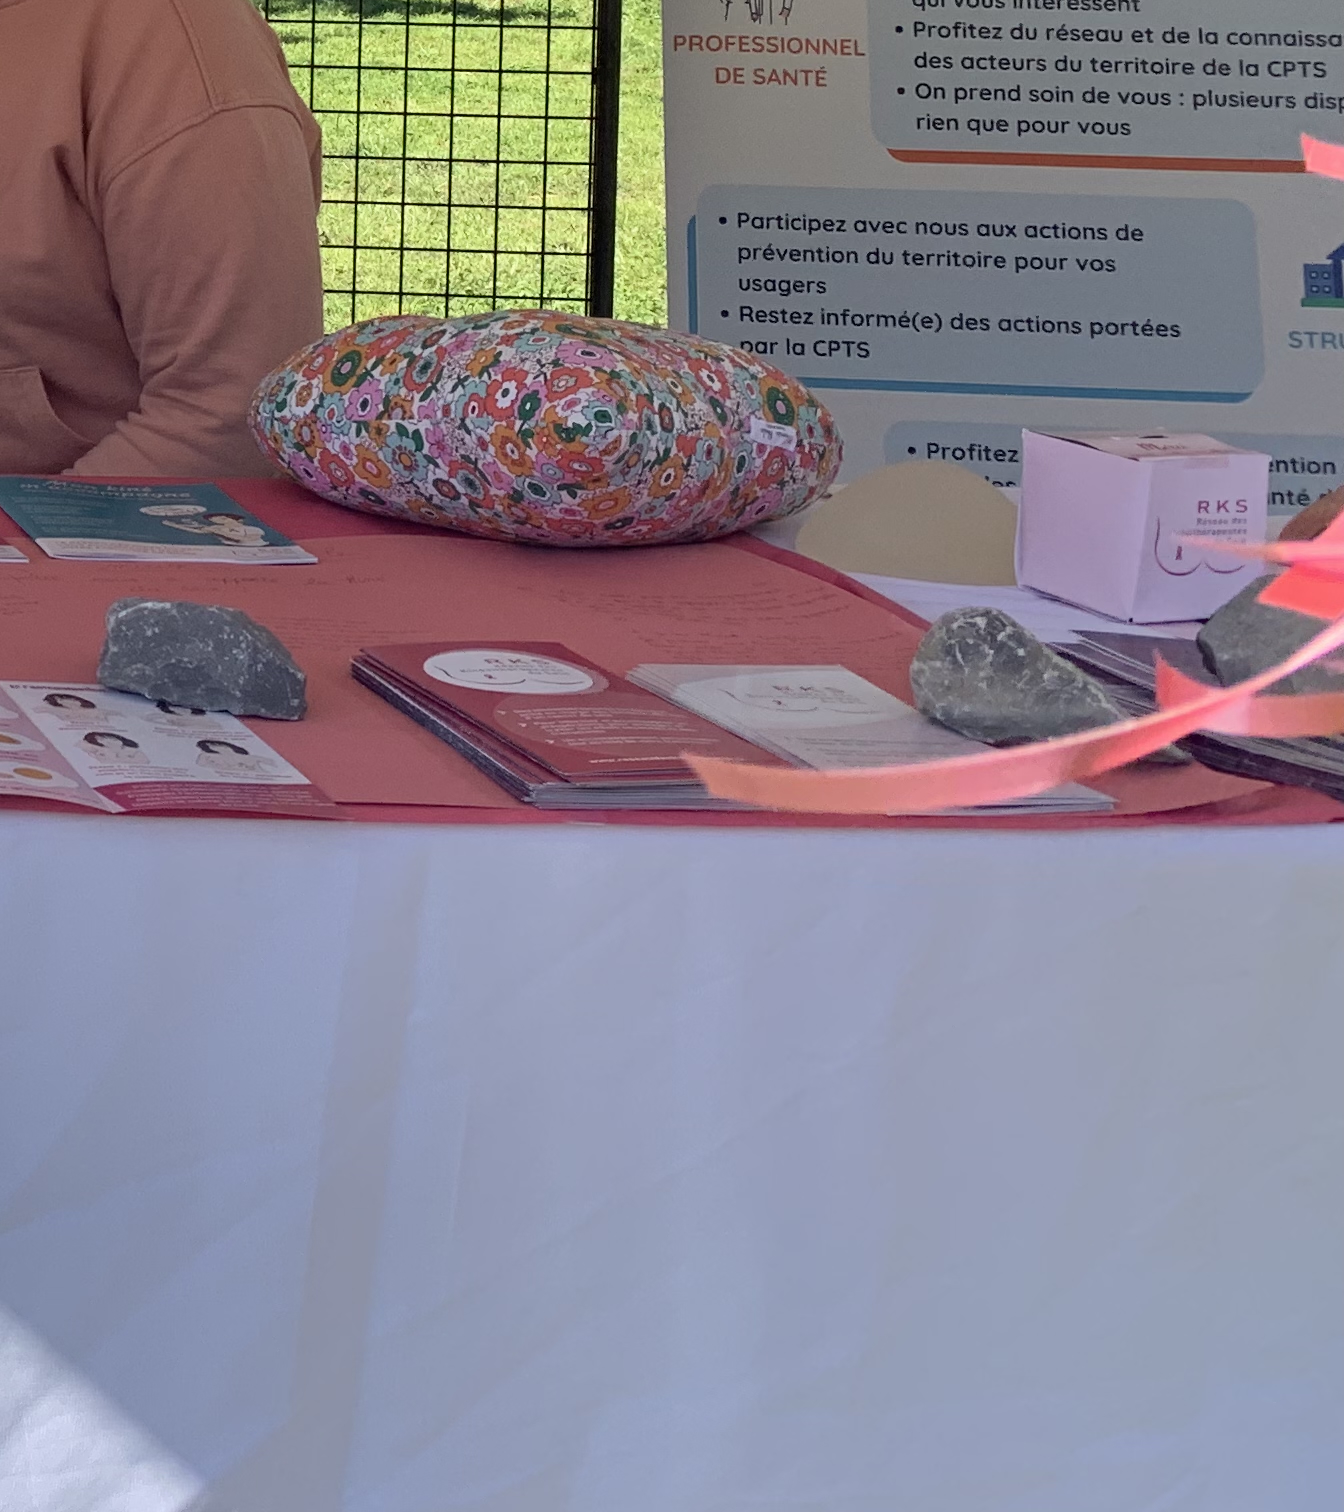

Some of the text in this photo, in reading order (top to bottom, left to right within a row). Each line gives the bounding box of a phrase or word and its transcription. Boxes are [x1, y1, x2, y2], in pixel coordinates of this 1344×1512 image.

[672, 34, 866, 57] PROFESSIONNEL
[715, 65, 828, 88] DE SANTÉ
[737, 212, 1144, 242] Participez avec nous aux actions de
[738, 278, 827, 297] usagers
[1288, 330, 1344, 350] STRU
[1197, 499, 1248, 514] RKS
